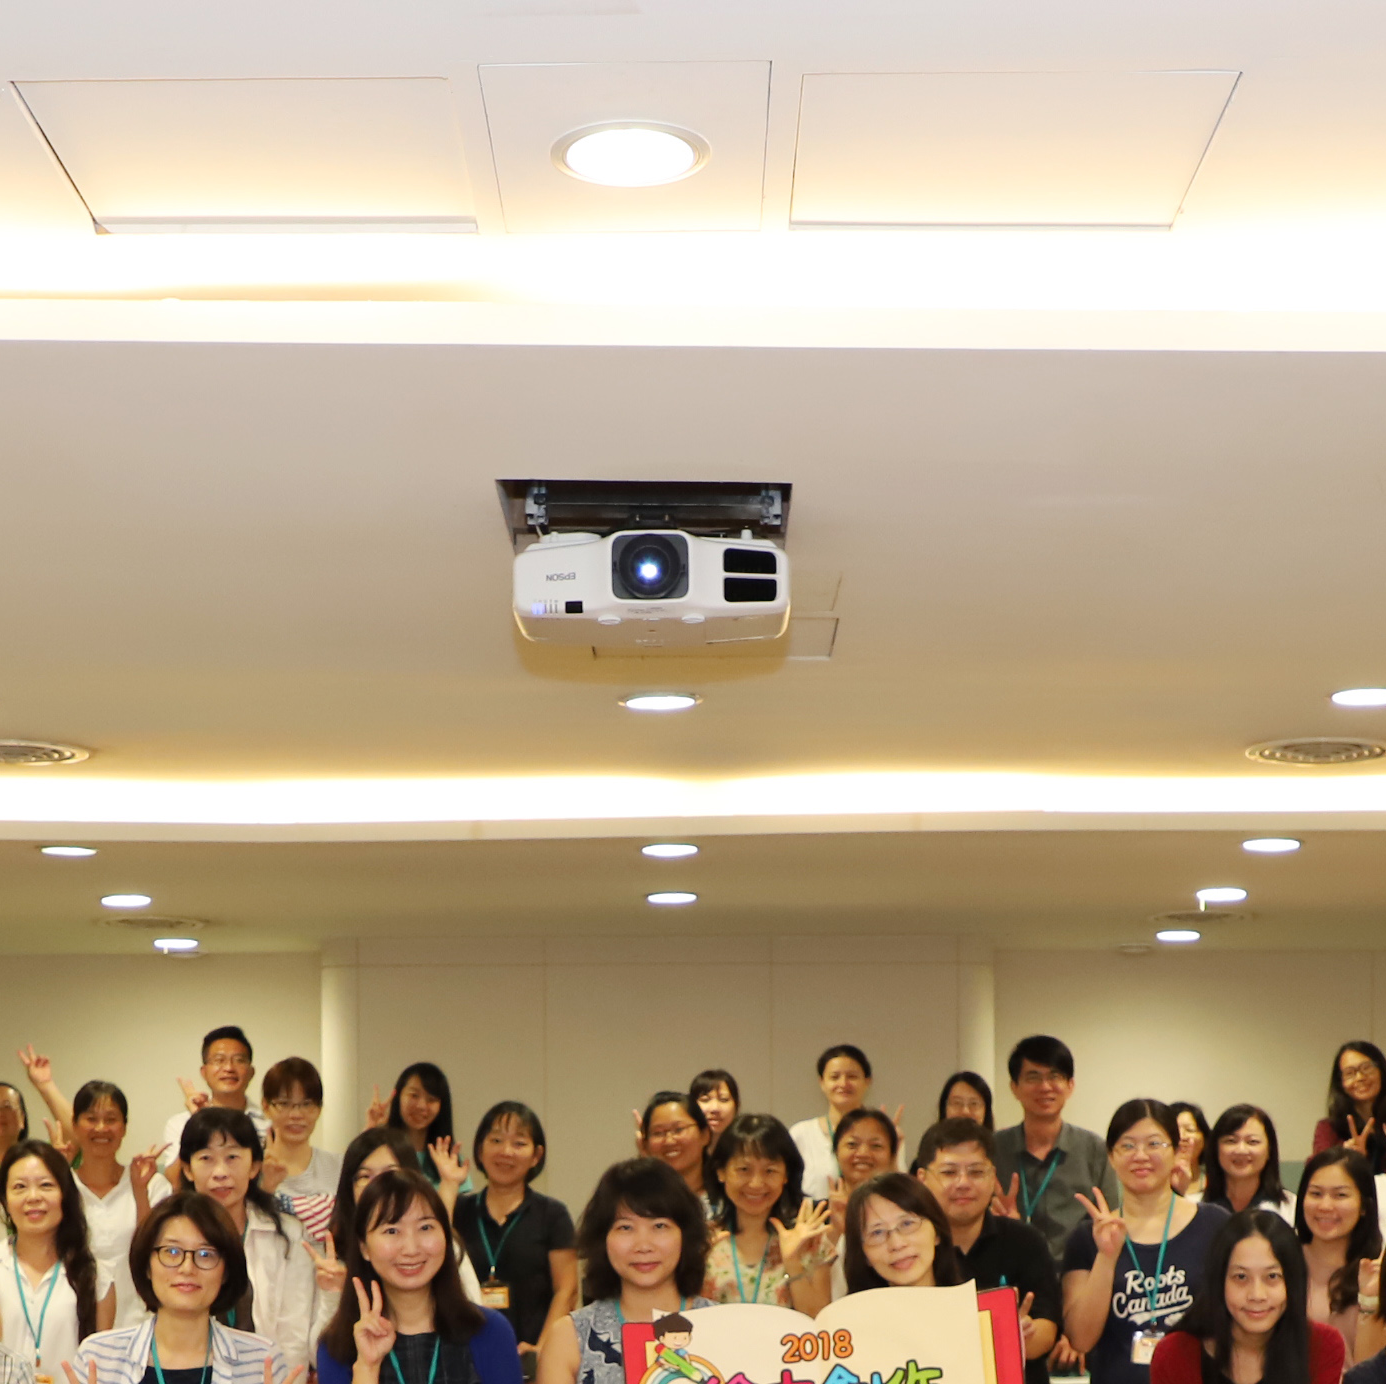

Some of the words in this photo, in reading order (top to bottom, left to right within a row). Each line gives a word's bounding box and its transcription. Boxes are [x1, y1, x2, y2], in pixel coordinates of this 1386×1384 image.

[545, 572, 576, 582] EPSON
[1124, 1265, 1186, 1295] Roots
[1113, 1283, 1190, 1319] Canada
[780, 1329, 854, 1364] 2018
